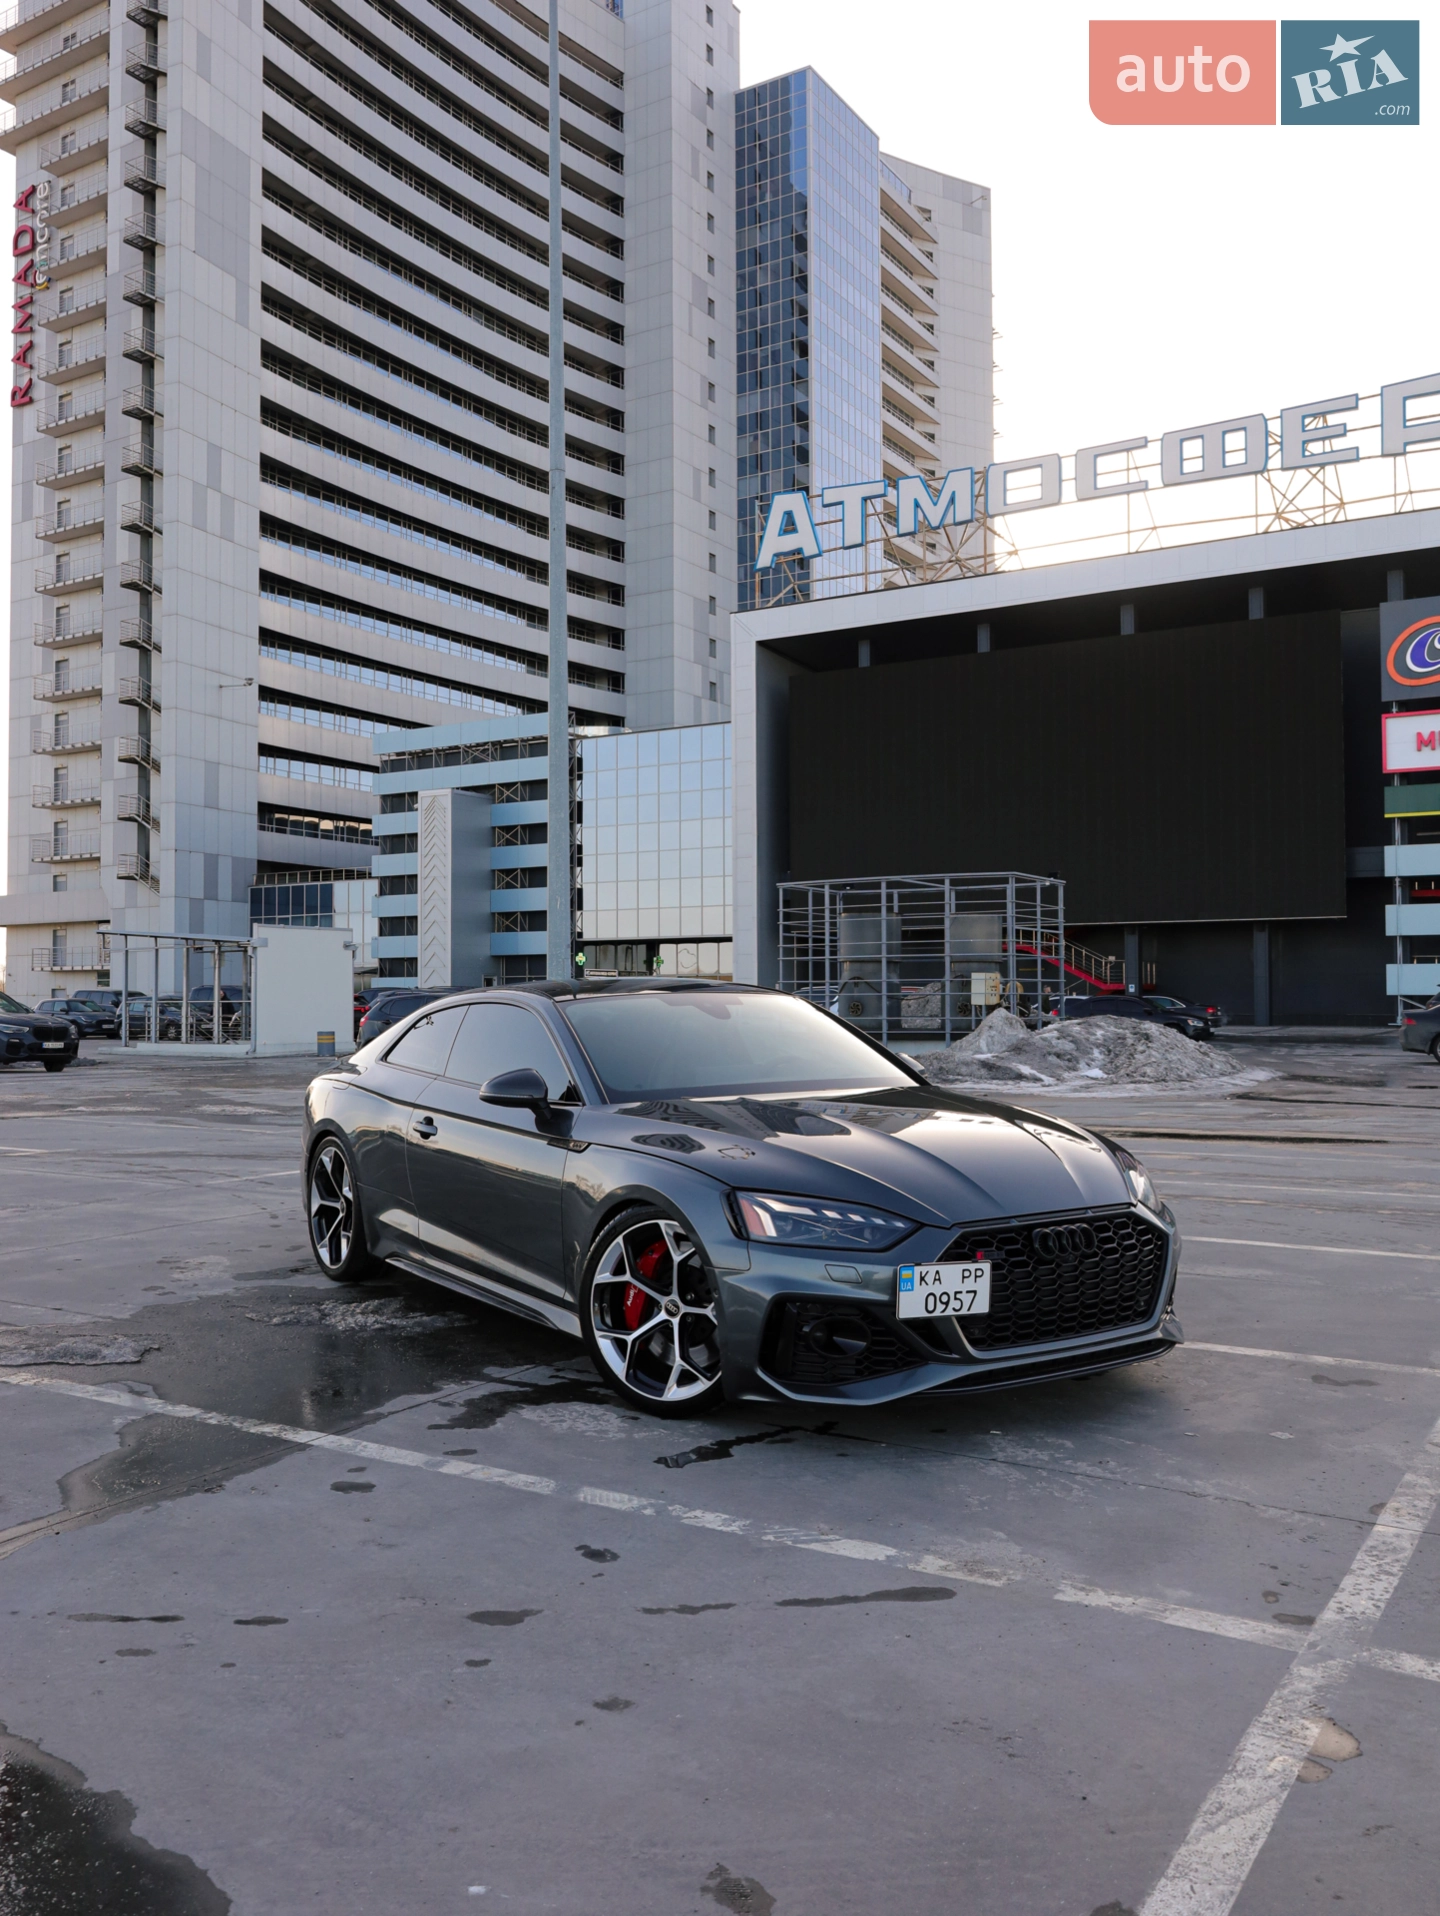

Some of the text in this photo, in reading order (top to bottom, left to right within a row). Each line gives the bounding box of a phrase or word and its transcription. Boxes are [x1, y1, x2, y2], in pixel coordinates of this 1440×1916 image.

[35, 181, 50, 285] encore
[11, 184, 36, 408] RAMADA
[901, 1282, 912, 1290] UA
[919, 1268, 985, 1286] KA PP
[924, 1289, 978, 1315] 0957
